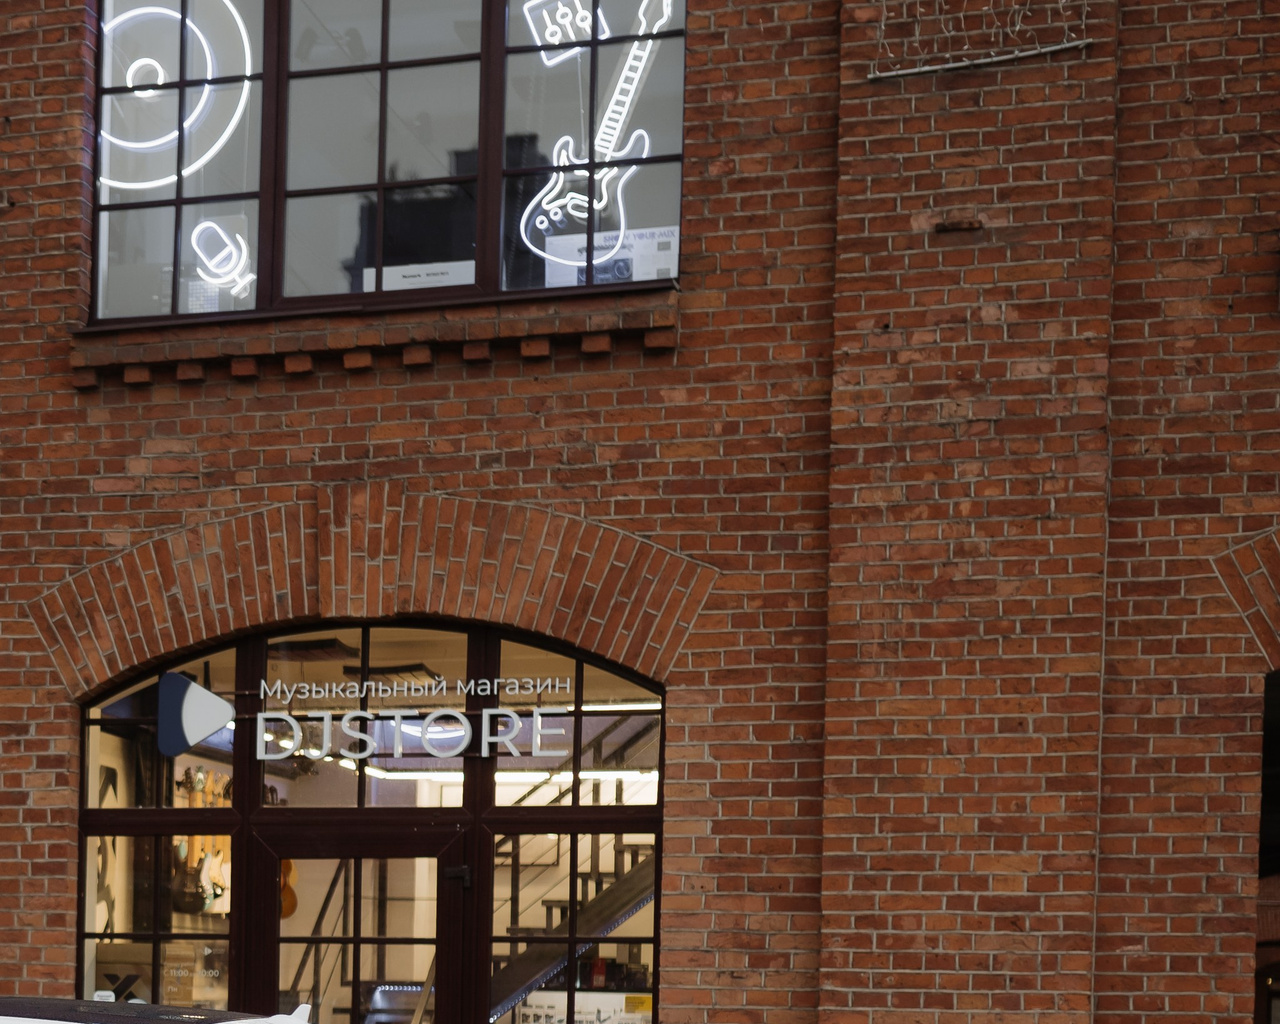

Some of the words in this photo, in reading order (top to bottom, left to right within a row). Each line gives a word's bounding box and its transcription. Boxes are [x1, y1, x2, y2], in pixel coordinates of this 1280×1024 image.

[259, 675, 448, 705] Музыкальный
[456, 676, 571, 696] магазин
[256, 708, 570, 760] DJSTORE
